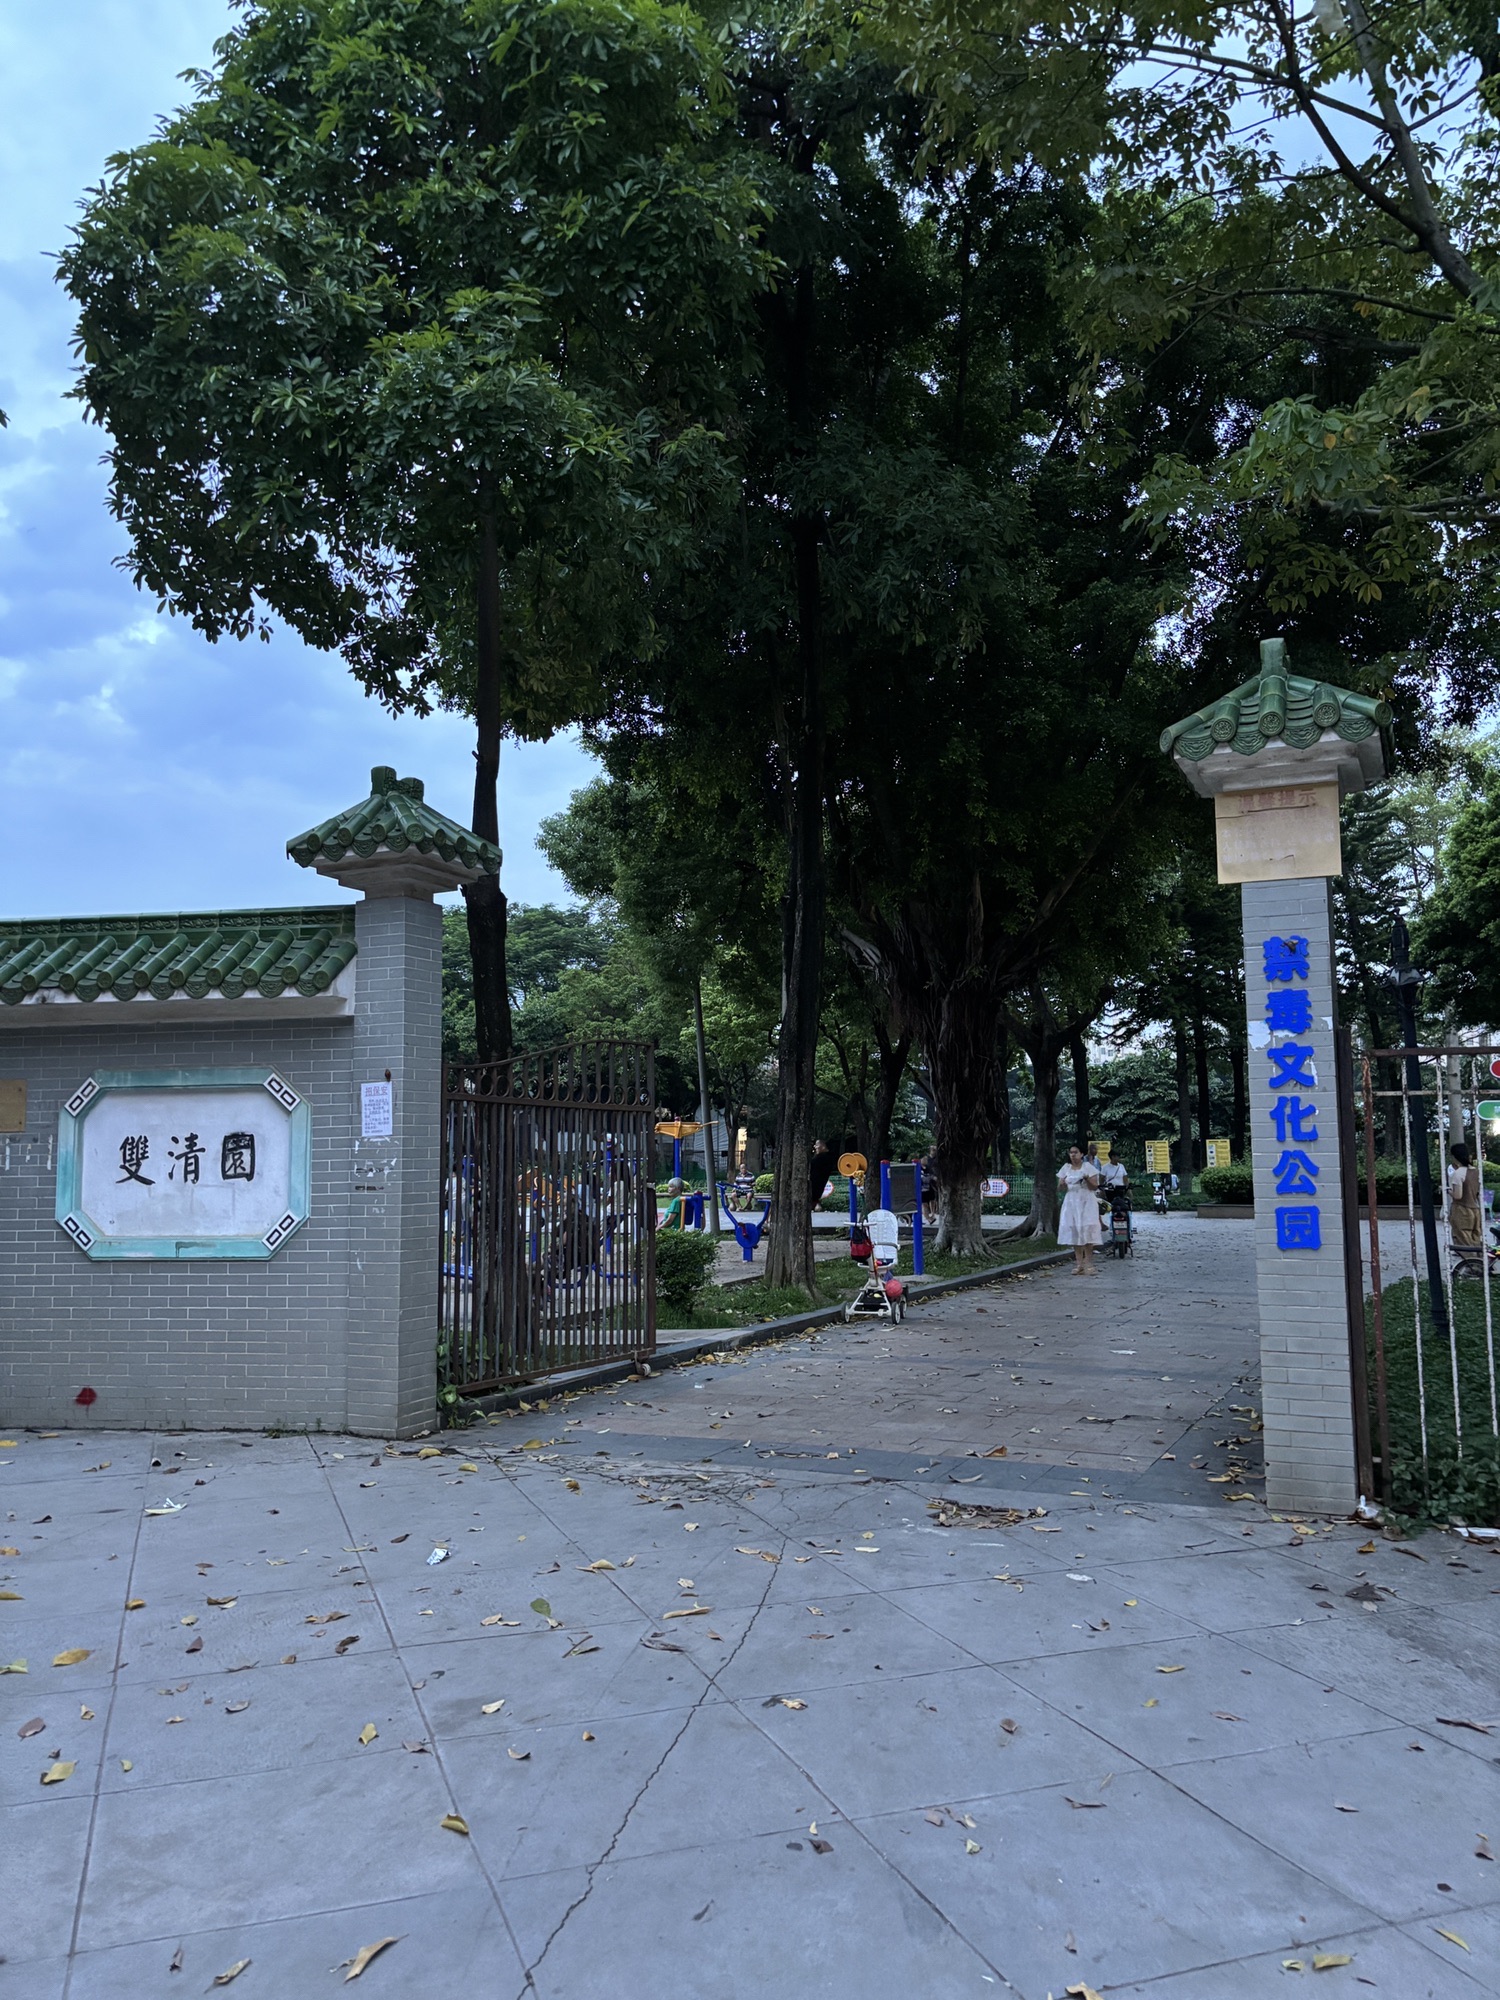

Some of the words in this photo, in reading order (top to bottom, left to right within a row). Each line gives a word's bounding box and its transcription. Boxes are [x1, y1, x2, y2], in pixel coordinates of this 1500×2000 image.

[116, 1132, 256, 1185] 雙清園
[1263, 935, 1322, 1251] 禁毒文化公园
